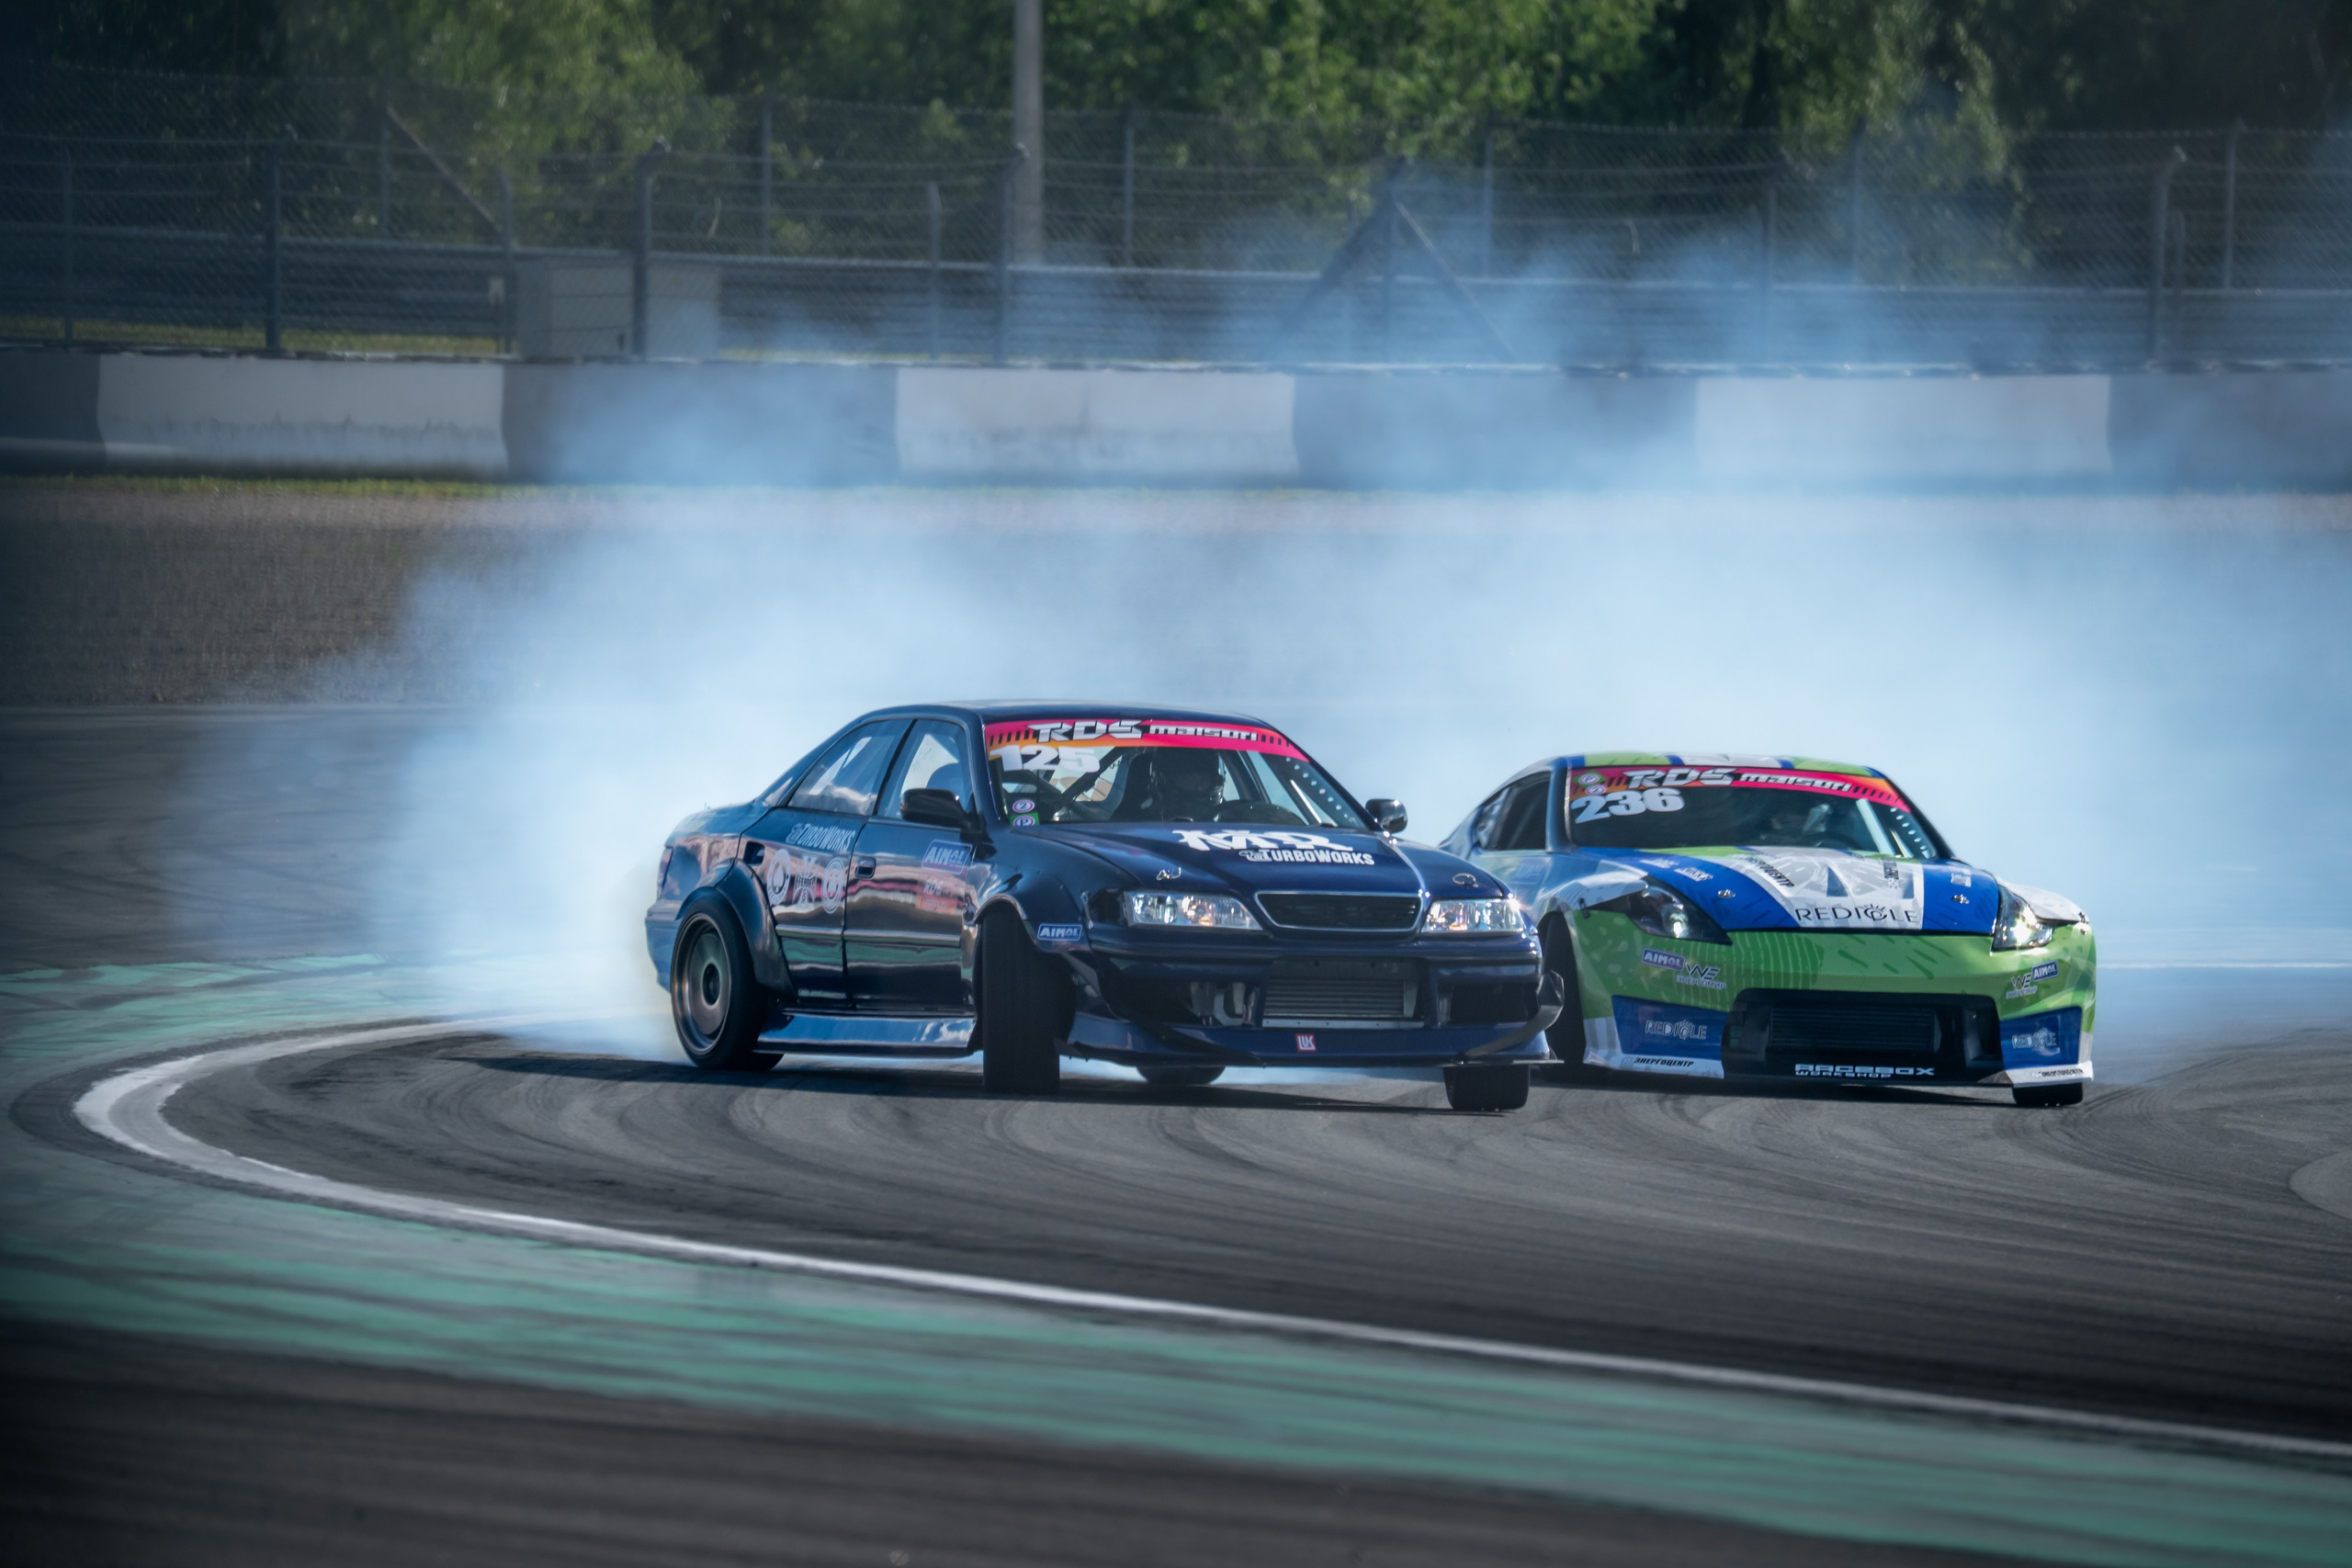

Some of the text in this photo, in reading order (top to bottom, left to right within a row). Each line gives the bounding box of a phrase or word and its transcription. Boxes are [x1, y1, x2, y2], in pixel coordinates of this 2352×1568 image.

[1027, 720, 1143, 743] RDS
[989, 744, 1101, 773] 125
[1622, 768, 1740, 789] RDS
[1570, 787, 1686, 825] 236
[924, 846, 966, 865] AIMOL
[1039, 927, 1079, 938] AIMOL
[1644, 952, 1682, 966] AIMOL
[1634, 1057, 1694, 1067] ЭНЕРГОЦЕНТР
